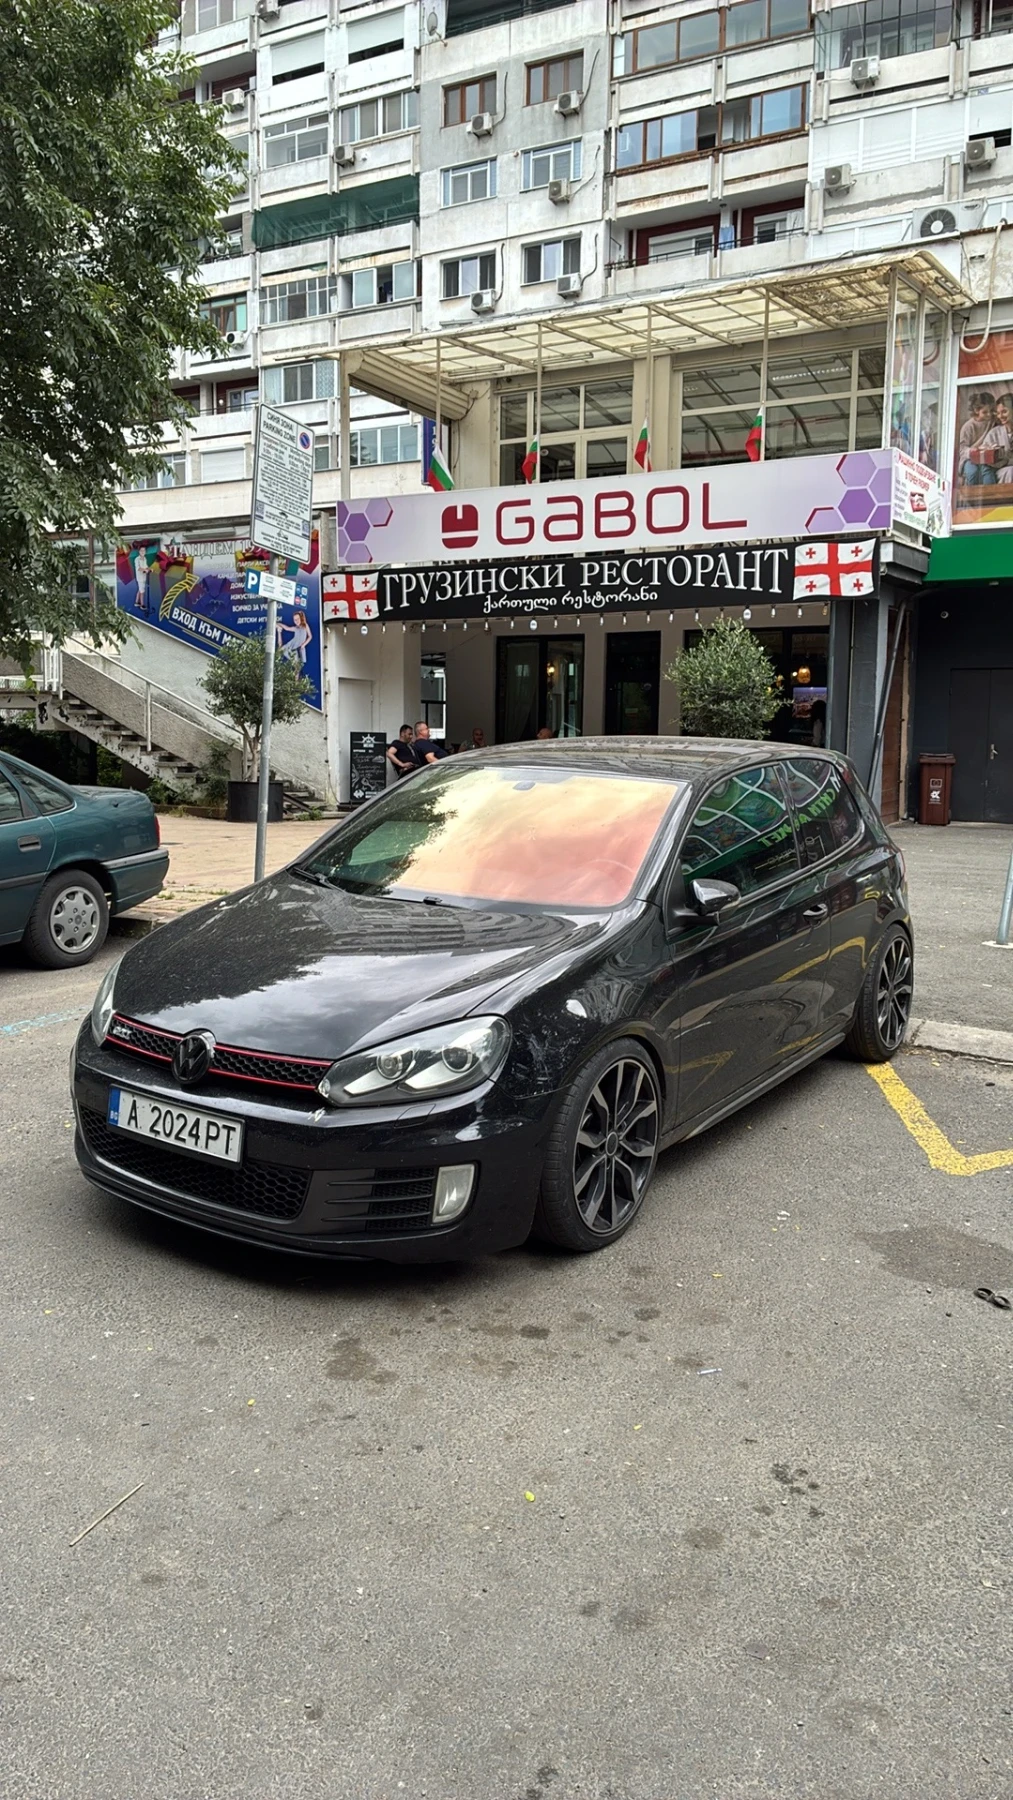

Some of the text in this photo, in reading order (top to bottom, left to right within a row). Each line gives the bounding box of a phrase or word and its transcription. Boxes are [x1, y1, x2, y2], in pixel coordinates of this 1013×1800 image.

[263, 420, 296, 443] PARKING ZONE
[281, 419, 294, 432] ЗОНА
[247, 571, 258, 589] P
[382, 548, 789, 612] ГРУЗИНСКИ РЕСТОРАНТ
[483, 585, 659, 614] ქართული რესტორანი
[171, 607, 197, 631] ВХОД
[198, 621, 221, 642] КЪМ
[109, 1109, 119, 1121] BG
[127, 1098, 139, 1129] A
